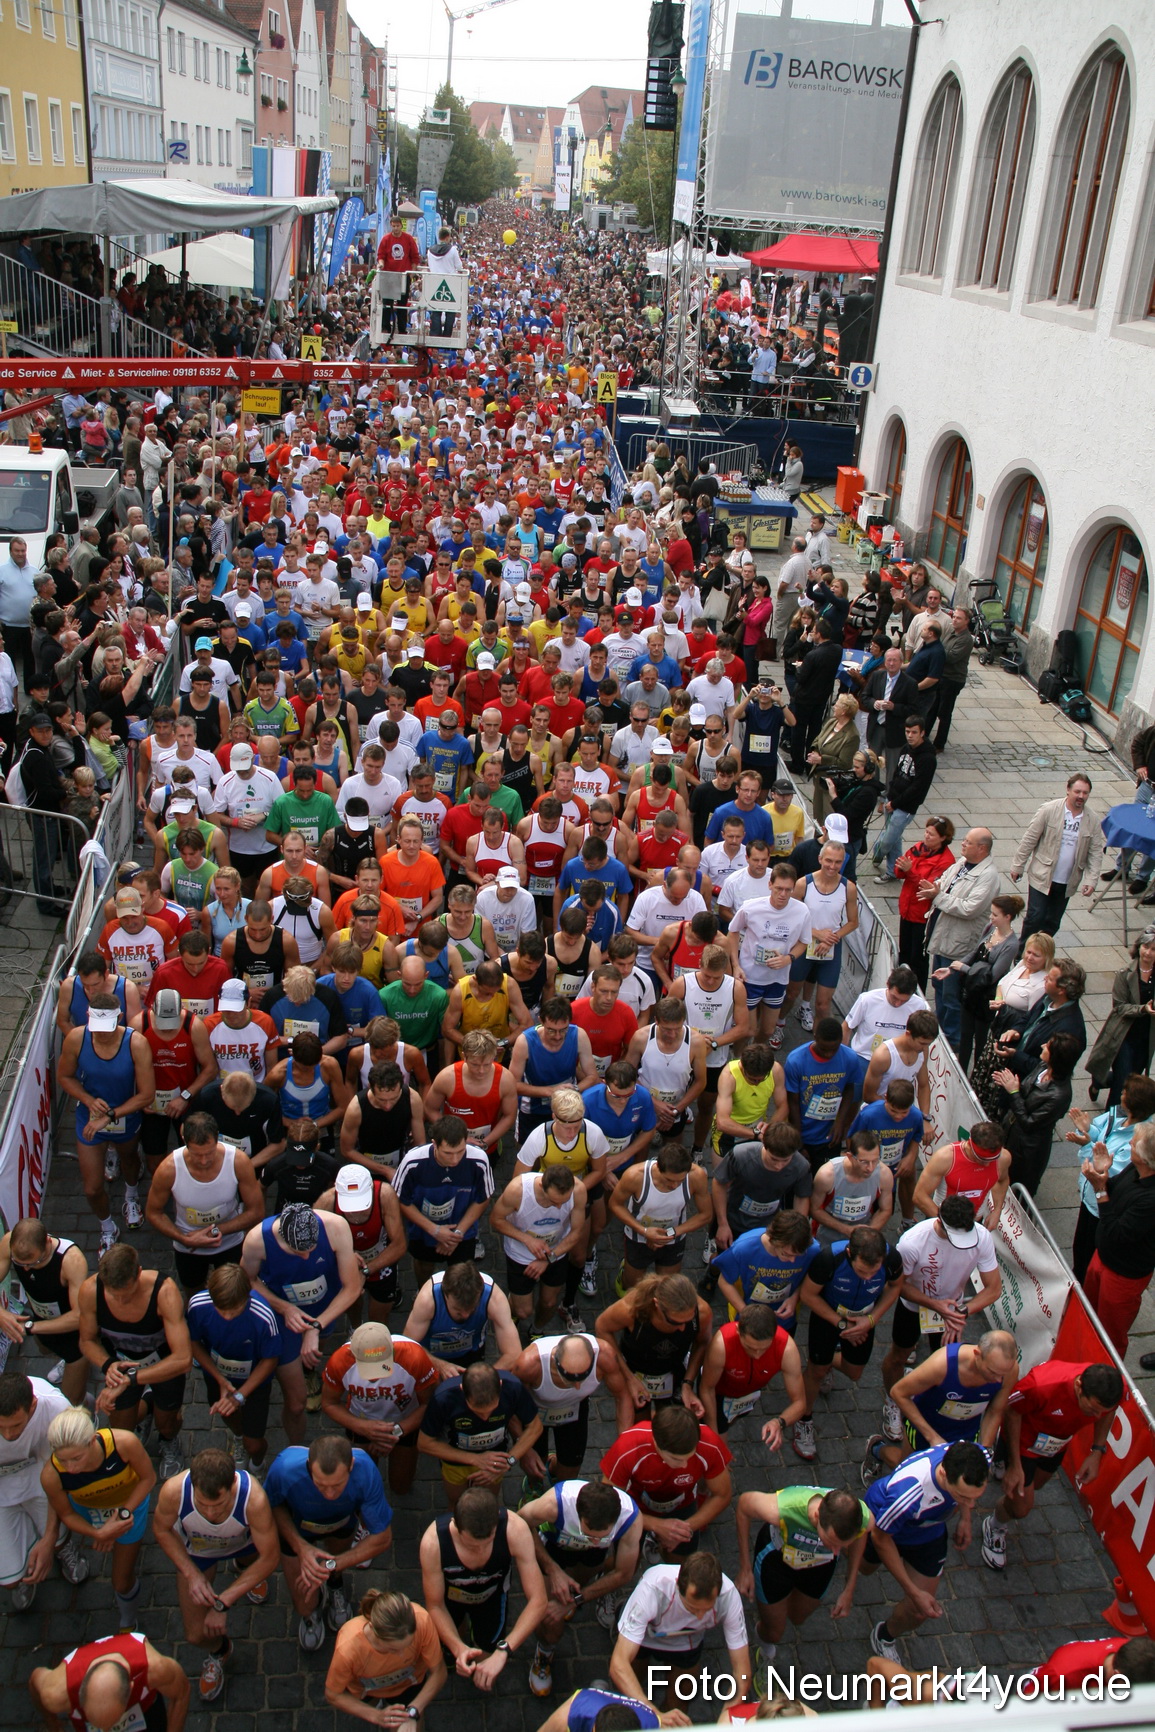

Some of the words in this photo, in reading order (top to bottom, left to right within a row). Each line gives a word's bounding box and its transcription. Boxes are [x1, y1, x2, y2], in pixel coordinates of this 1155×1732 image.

[788, 58, 904, 89] BAROWSK
[788, 81, 855, 95] Veranstaltungs-
[780, 189, 886, 210] www.barowski-ag
[305, 344, 316, 360] A
[18, 368, 57, 378] Service
[80, 368, 106, 378] Miet-
[108, 368, 115, 377] &
[117, 368, 171, 378] Serviceline:
[172, 368, 198, 377] 09181
[200, 368, 221, 376] 6352
[314, 370, 334, 378] 6352
[602, 381, 612, 396] A
[244, 392, 278, 402] Schnupper-
[752, 518, 780, 531] Glossner
[290, 816, 319, 825] Sinupret
[177, 878, 202, 890] BOCK
[113, 944, 155, 958] MERZ
[131, 971, 148, 979] 504
[256, 980, 266, 988] 39
[562, 983, 580, 991] 1018
[192, 1008, 210, 1016] 845
[394, 1010, 428, 1020] Sinupret
[294, 1021, 308, 1029] Stefan
[214, 1044, 259, 1057] MERZ
[818, 1106, 836, 1114] 2535
[431, 1205, 453, 1217] 2983
[844, 1205, 866, 1214] 3528
[202, 1214, 222, 1223] 681
[1012, 1226, 1023, 1240] 52
[758, 1266, 802, 1275] NEUMARKTER
[996, 1220, 1052, 1319] a-gebaeudeservice.de
[996, 1253, 1024, 1315] ereinigung
[299, 1285, 324, 1298] 3781
[218, 1363, 246, 1374] 3825
[648, 1382, 666, 1390] 571
[549, 1411, 574, 1421] 6019
[472, 1436, 499, 1447] 2007
[796, 1550, 815, 1559] Frank
